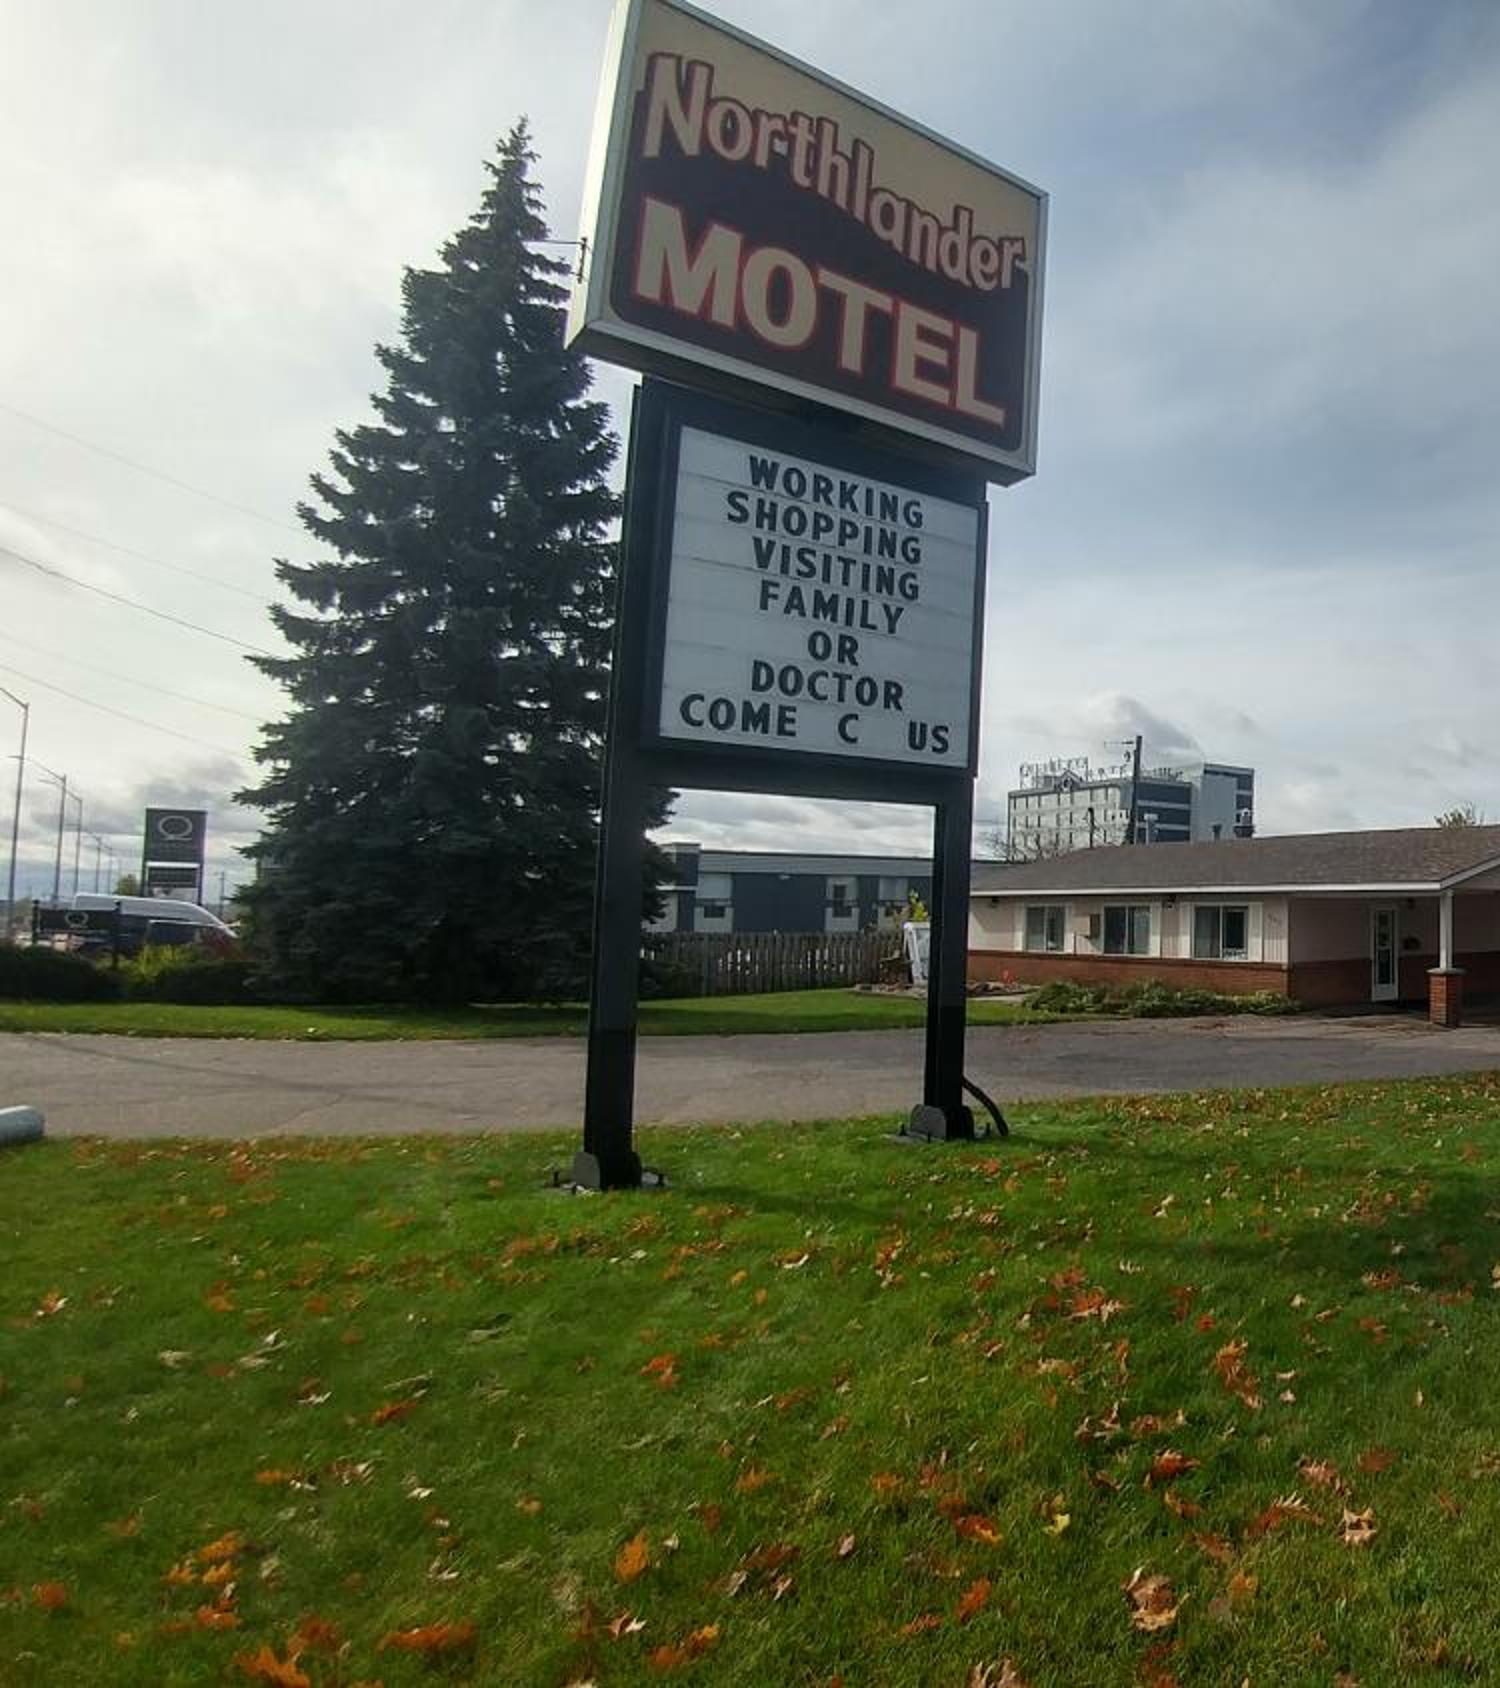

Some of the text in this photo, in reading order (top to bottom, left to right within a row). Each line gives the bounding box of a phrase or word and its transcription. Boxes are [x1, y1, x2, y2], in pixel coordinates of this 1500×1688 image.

[642, 53, 1027, 291] Northlander
[635, 194, 1006, 427] MOTEL
[749, 455, 923, 529] WORKING
[727, 491, 921, 565] SHOPPING
[752, 537, 919, 601] VISITING
[759, 580, 904, 635] FAMILY
[808, 631, 859, 666] OR
[752, 660, 903, 711] DOCTOR
[679, 694, 949, 754] COME C US
